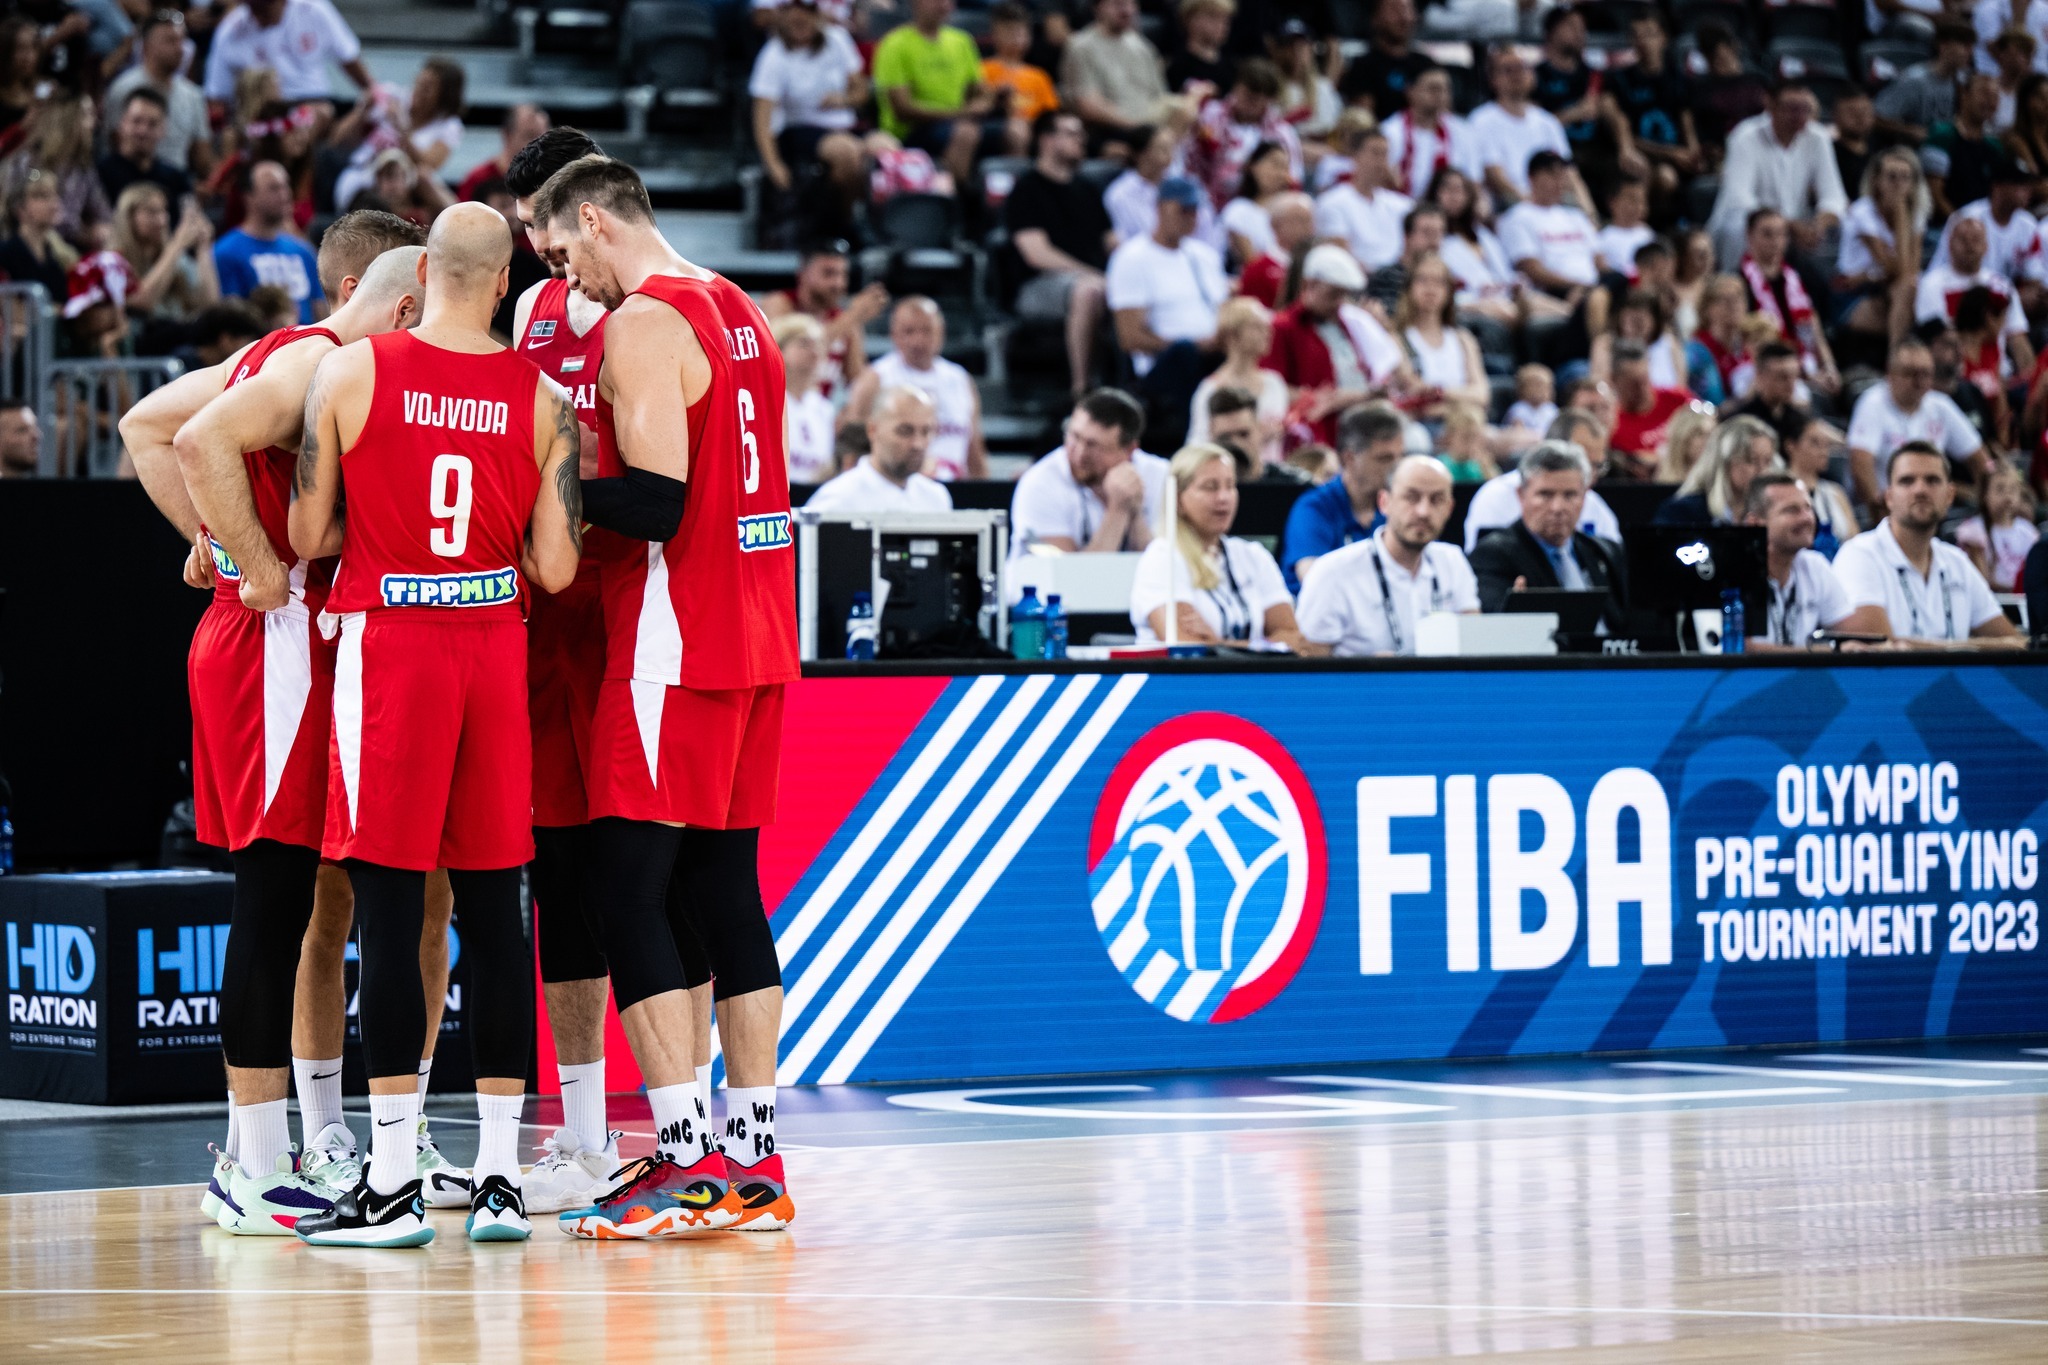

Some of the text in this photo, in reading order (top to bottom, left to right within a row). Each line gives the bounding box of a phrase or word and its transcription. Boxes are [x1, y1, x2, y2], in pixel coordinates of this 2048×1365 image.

[403, 390, 509, 435] VOJVODA
[737, 388, 760, 494] 6
[429, 453, 474, 558] 9
[1776, 761, 1960, 828] OLYMPIC
[1356, 767, 1672, 975] FIBA
[1695, 828, 2039, 900] PRE-QUALIFYING
[1696, 899, 2039, 963] TOURNAMENT 2023
[9, 993, 97, 1029] RATION
[138, 996, 221, 1029] RATI
[657, 1118, 693, 1145] ONG
